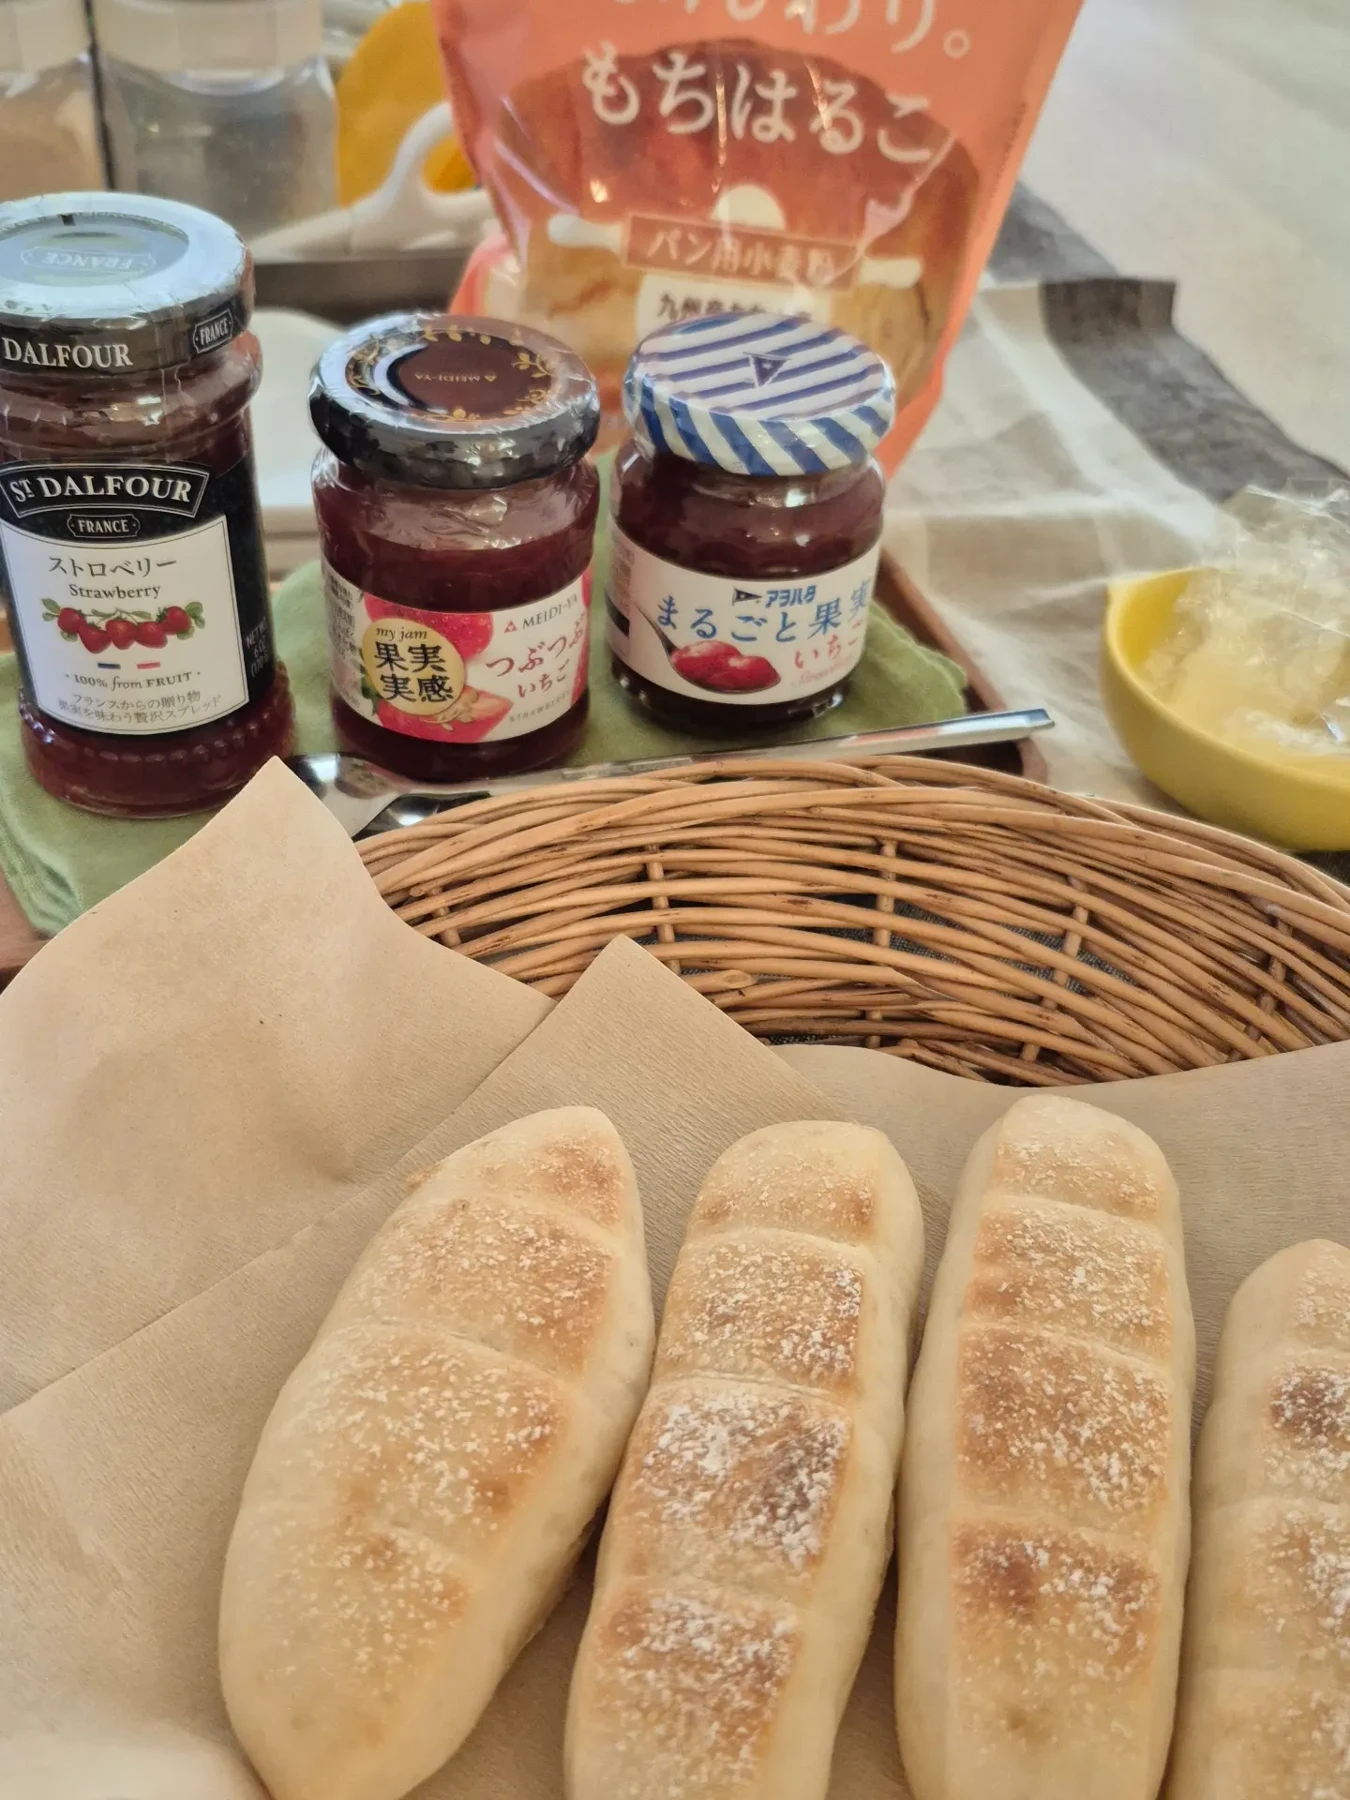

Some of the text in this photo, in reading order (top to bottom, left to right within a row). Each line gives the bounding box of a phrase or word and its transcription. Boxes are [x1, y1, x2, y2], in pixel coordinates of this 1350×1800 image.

[582, 41, 934, 163] もちはるこ
[43, 252, 134, 270] FRANCE
[199, 319, 230, 347] FRANCE
[1, 337, 134, 369] DALFOUR
[37, 475, 192, 502] DALFOUR
[78, 519, 130, 534] FRANCE
[48, 556, 177, 578] ストロベリー
[68, 584, 161, 600] Strawberry
[765, 585, 818, 609] アヲハタ
[656, 578, 872, 643] まるごと果実
[376, 627, 428, 640] my jam
[373, 641, 447, 673] 果実
[74, 671, 192, 691] 100% from FRUIT
[380, 673, 454, 702] 実感
